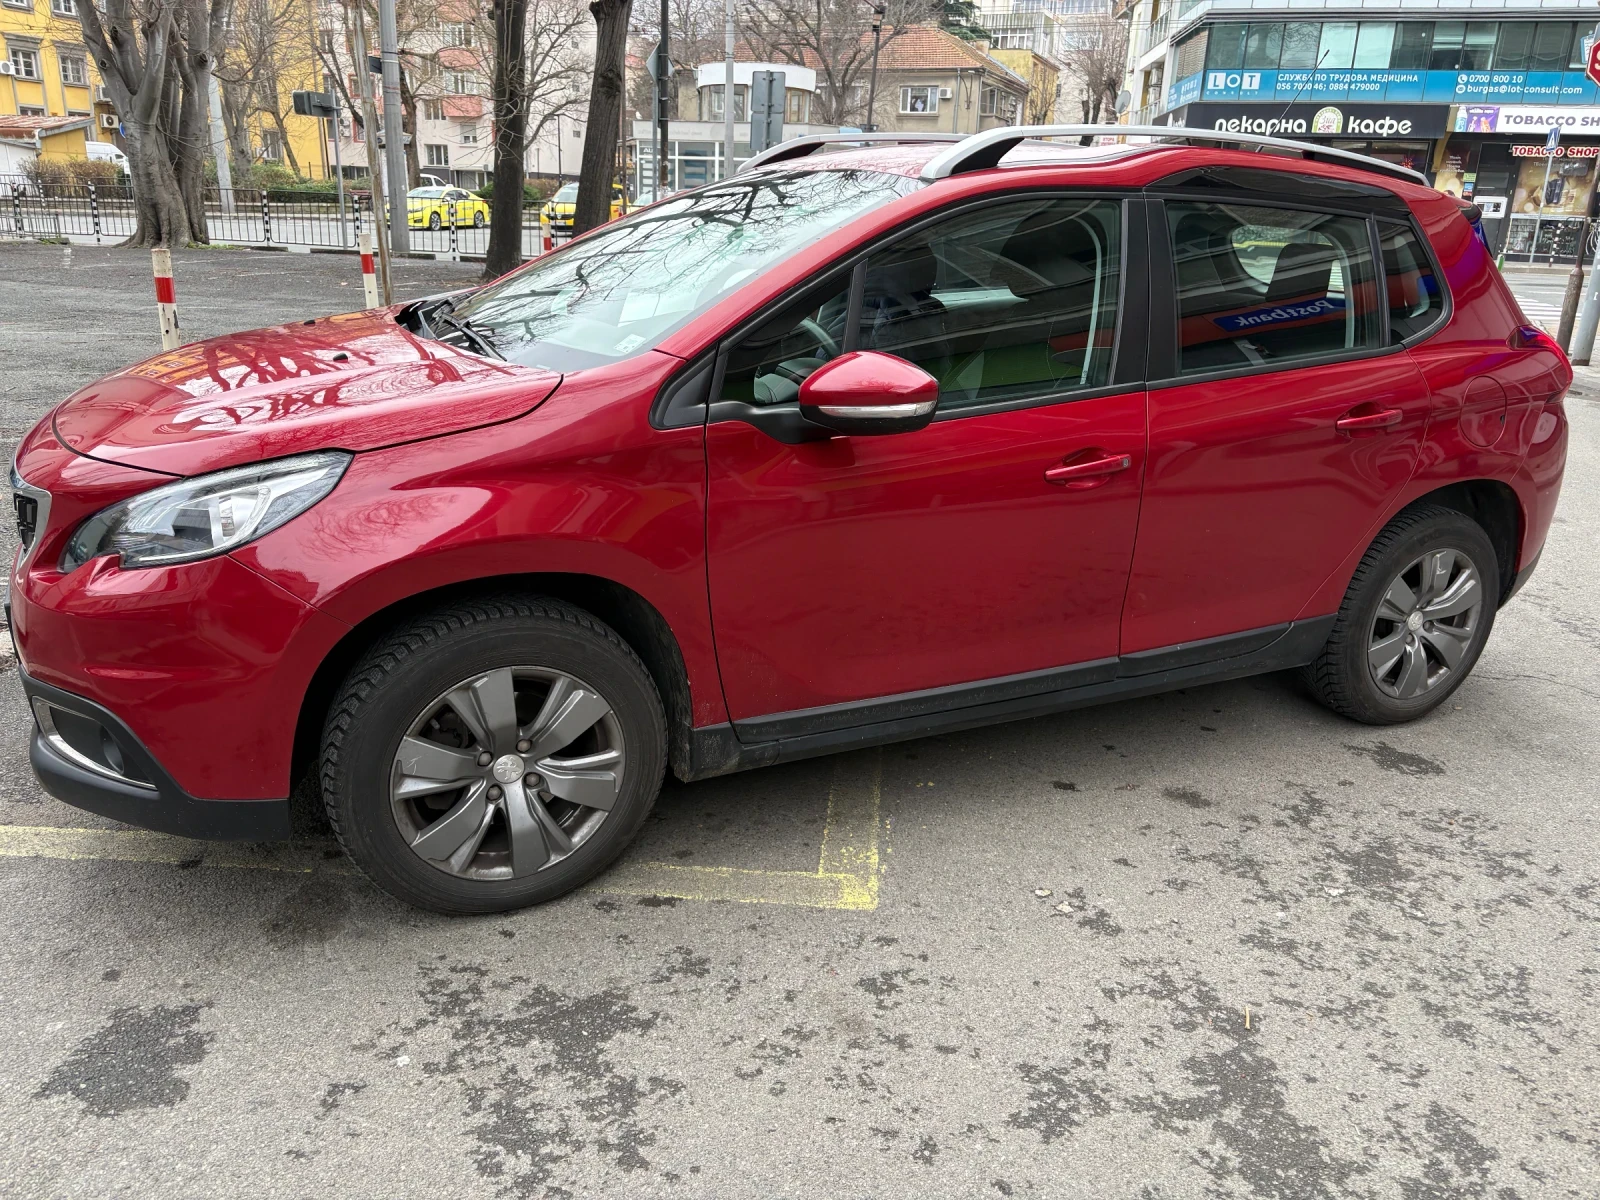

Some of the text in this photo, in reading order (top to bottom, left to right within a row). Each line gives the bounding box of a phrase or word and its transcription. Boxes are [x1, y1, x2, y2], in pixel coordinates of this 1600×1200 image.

[1209, 73, 1260, 89] LOT
[1277, 73, 1418, 83] СЛУЖБА ПО ТРУДОВА МЕДИЦИНА
[1469, 74, 1523, 83] 0700 800 10
[1276, 83, 1291, 91] 056
[1329, 83, 1348, 91] 0884
[1350, 83, 1380, 91] 479000
[1467, 84, 1582, 94] burgas@lot-consult.com
[1214, 116, 1306, 136] пекарна
[1504, 114, 1576, 126] TOBACCO
[1347, 116, 1412, 137] кафе
[1513, 146, 1600, 158] TOBACO SHOP
